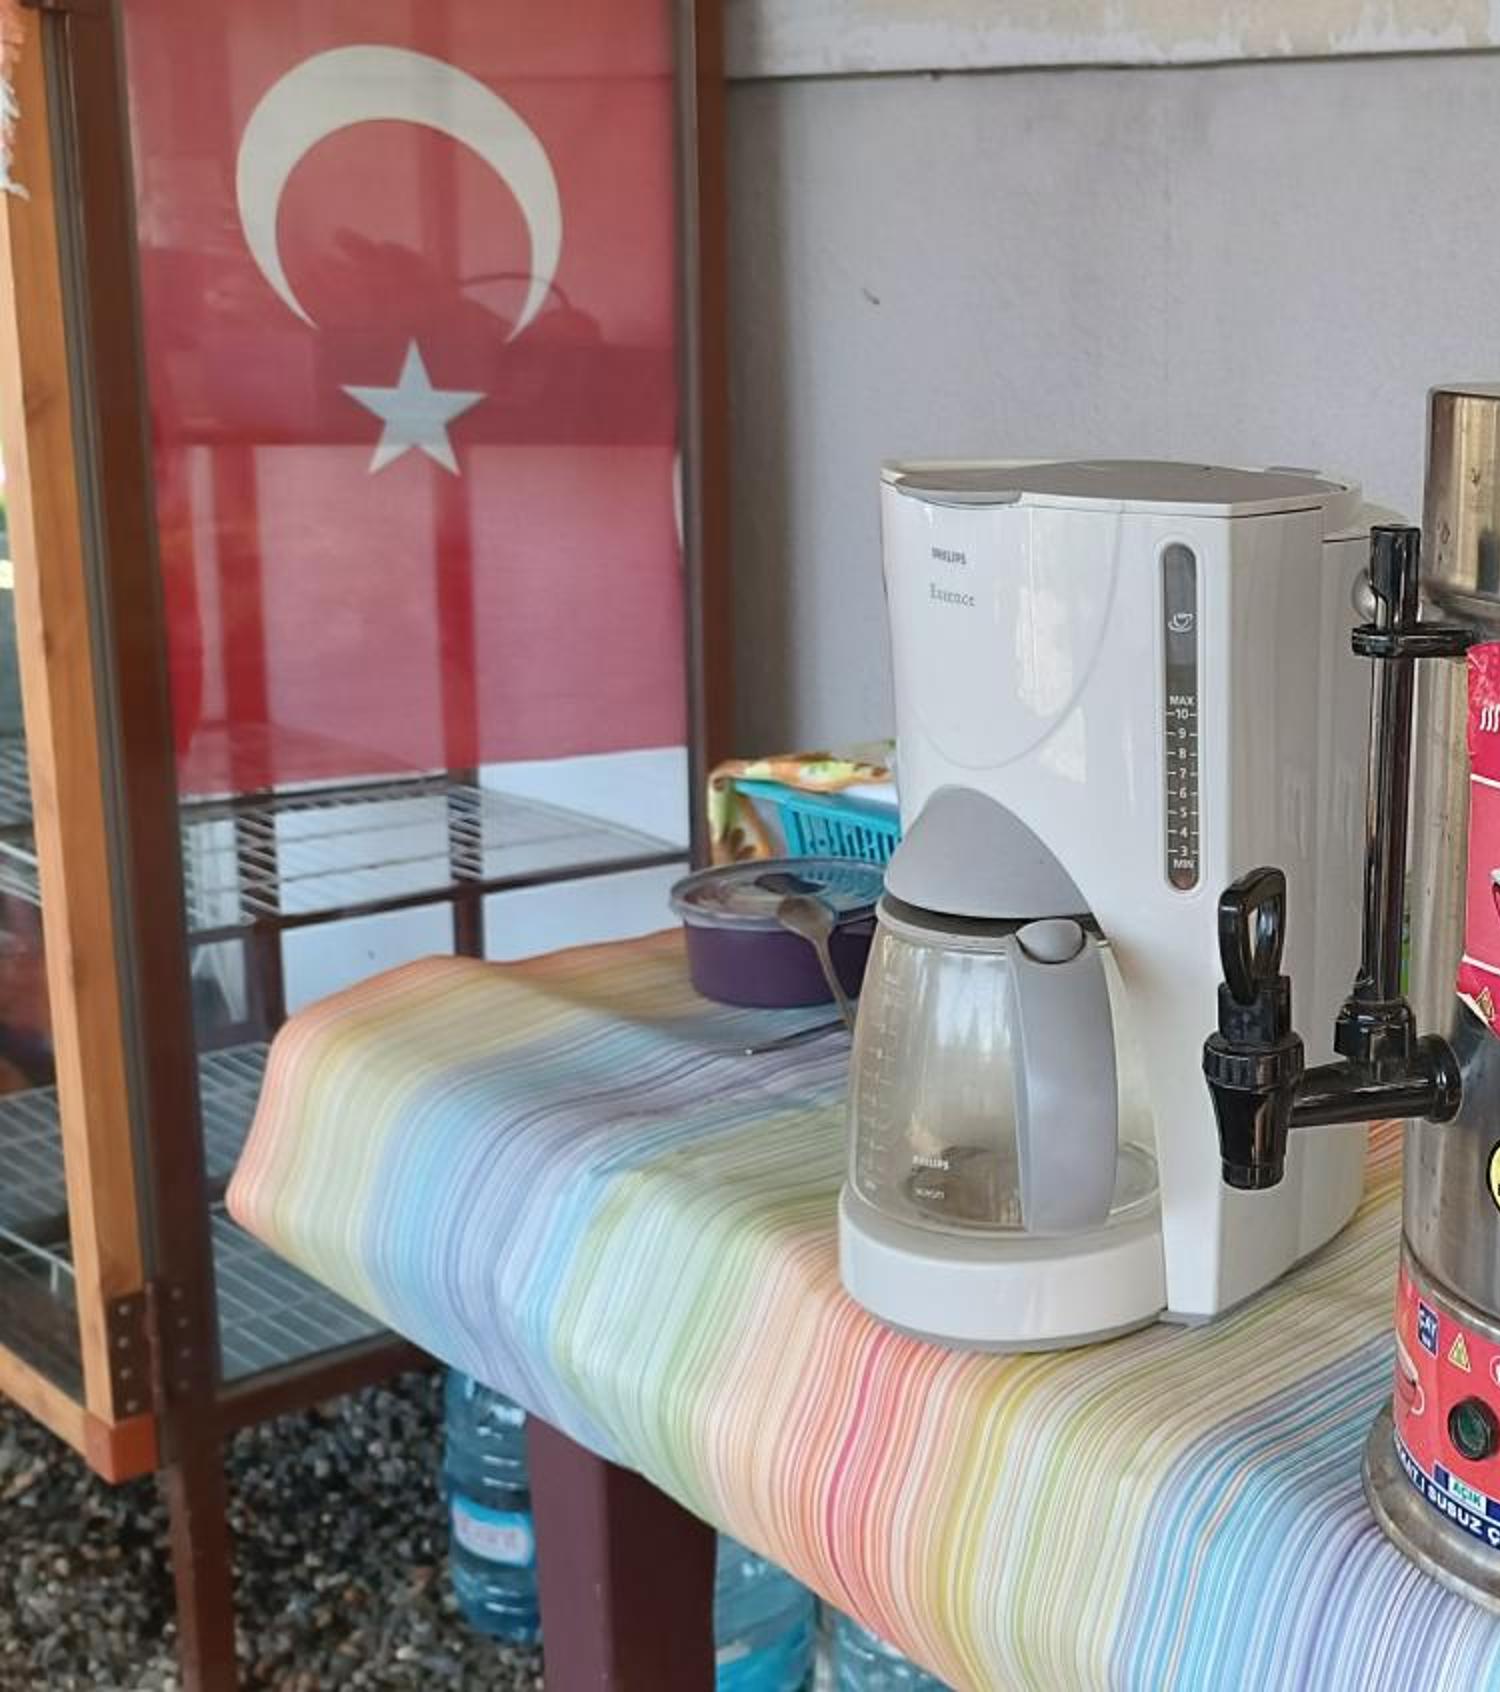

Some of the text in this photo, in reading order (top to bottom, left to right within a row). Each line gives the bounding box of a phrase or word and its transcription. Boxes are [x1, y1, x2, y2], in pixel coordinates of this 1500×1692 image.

[931, 547, 967, 565] PHILIPS
[1169, 695, 1195, 706] MAX
[1175, 708, 1189, 720] 10
[1178, 727, 1187, 739] 9
[1179, 747, 1187, 759] 8
[1180, 767, 1187, 778] 7
[1180, 787, 1187, 799] 6
[1180, 806, 1188, 818] 5
[1180, 826, 1188, 838] 4
[1180, 845, 1188, 857] 3
[1173, 859, 1194, 869] MIN
[1427, 1483, 1483, 1536] SUSUZ
